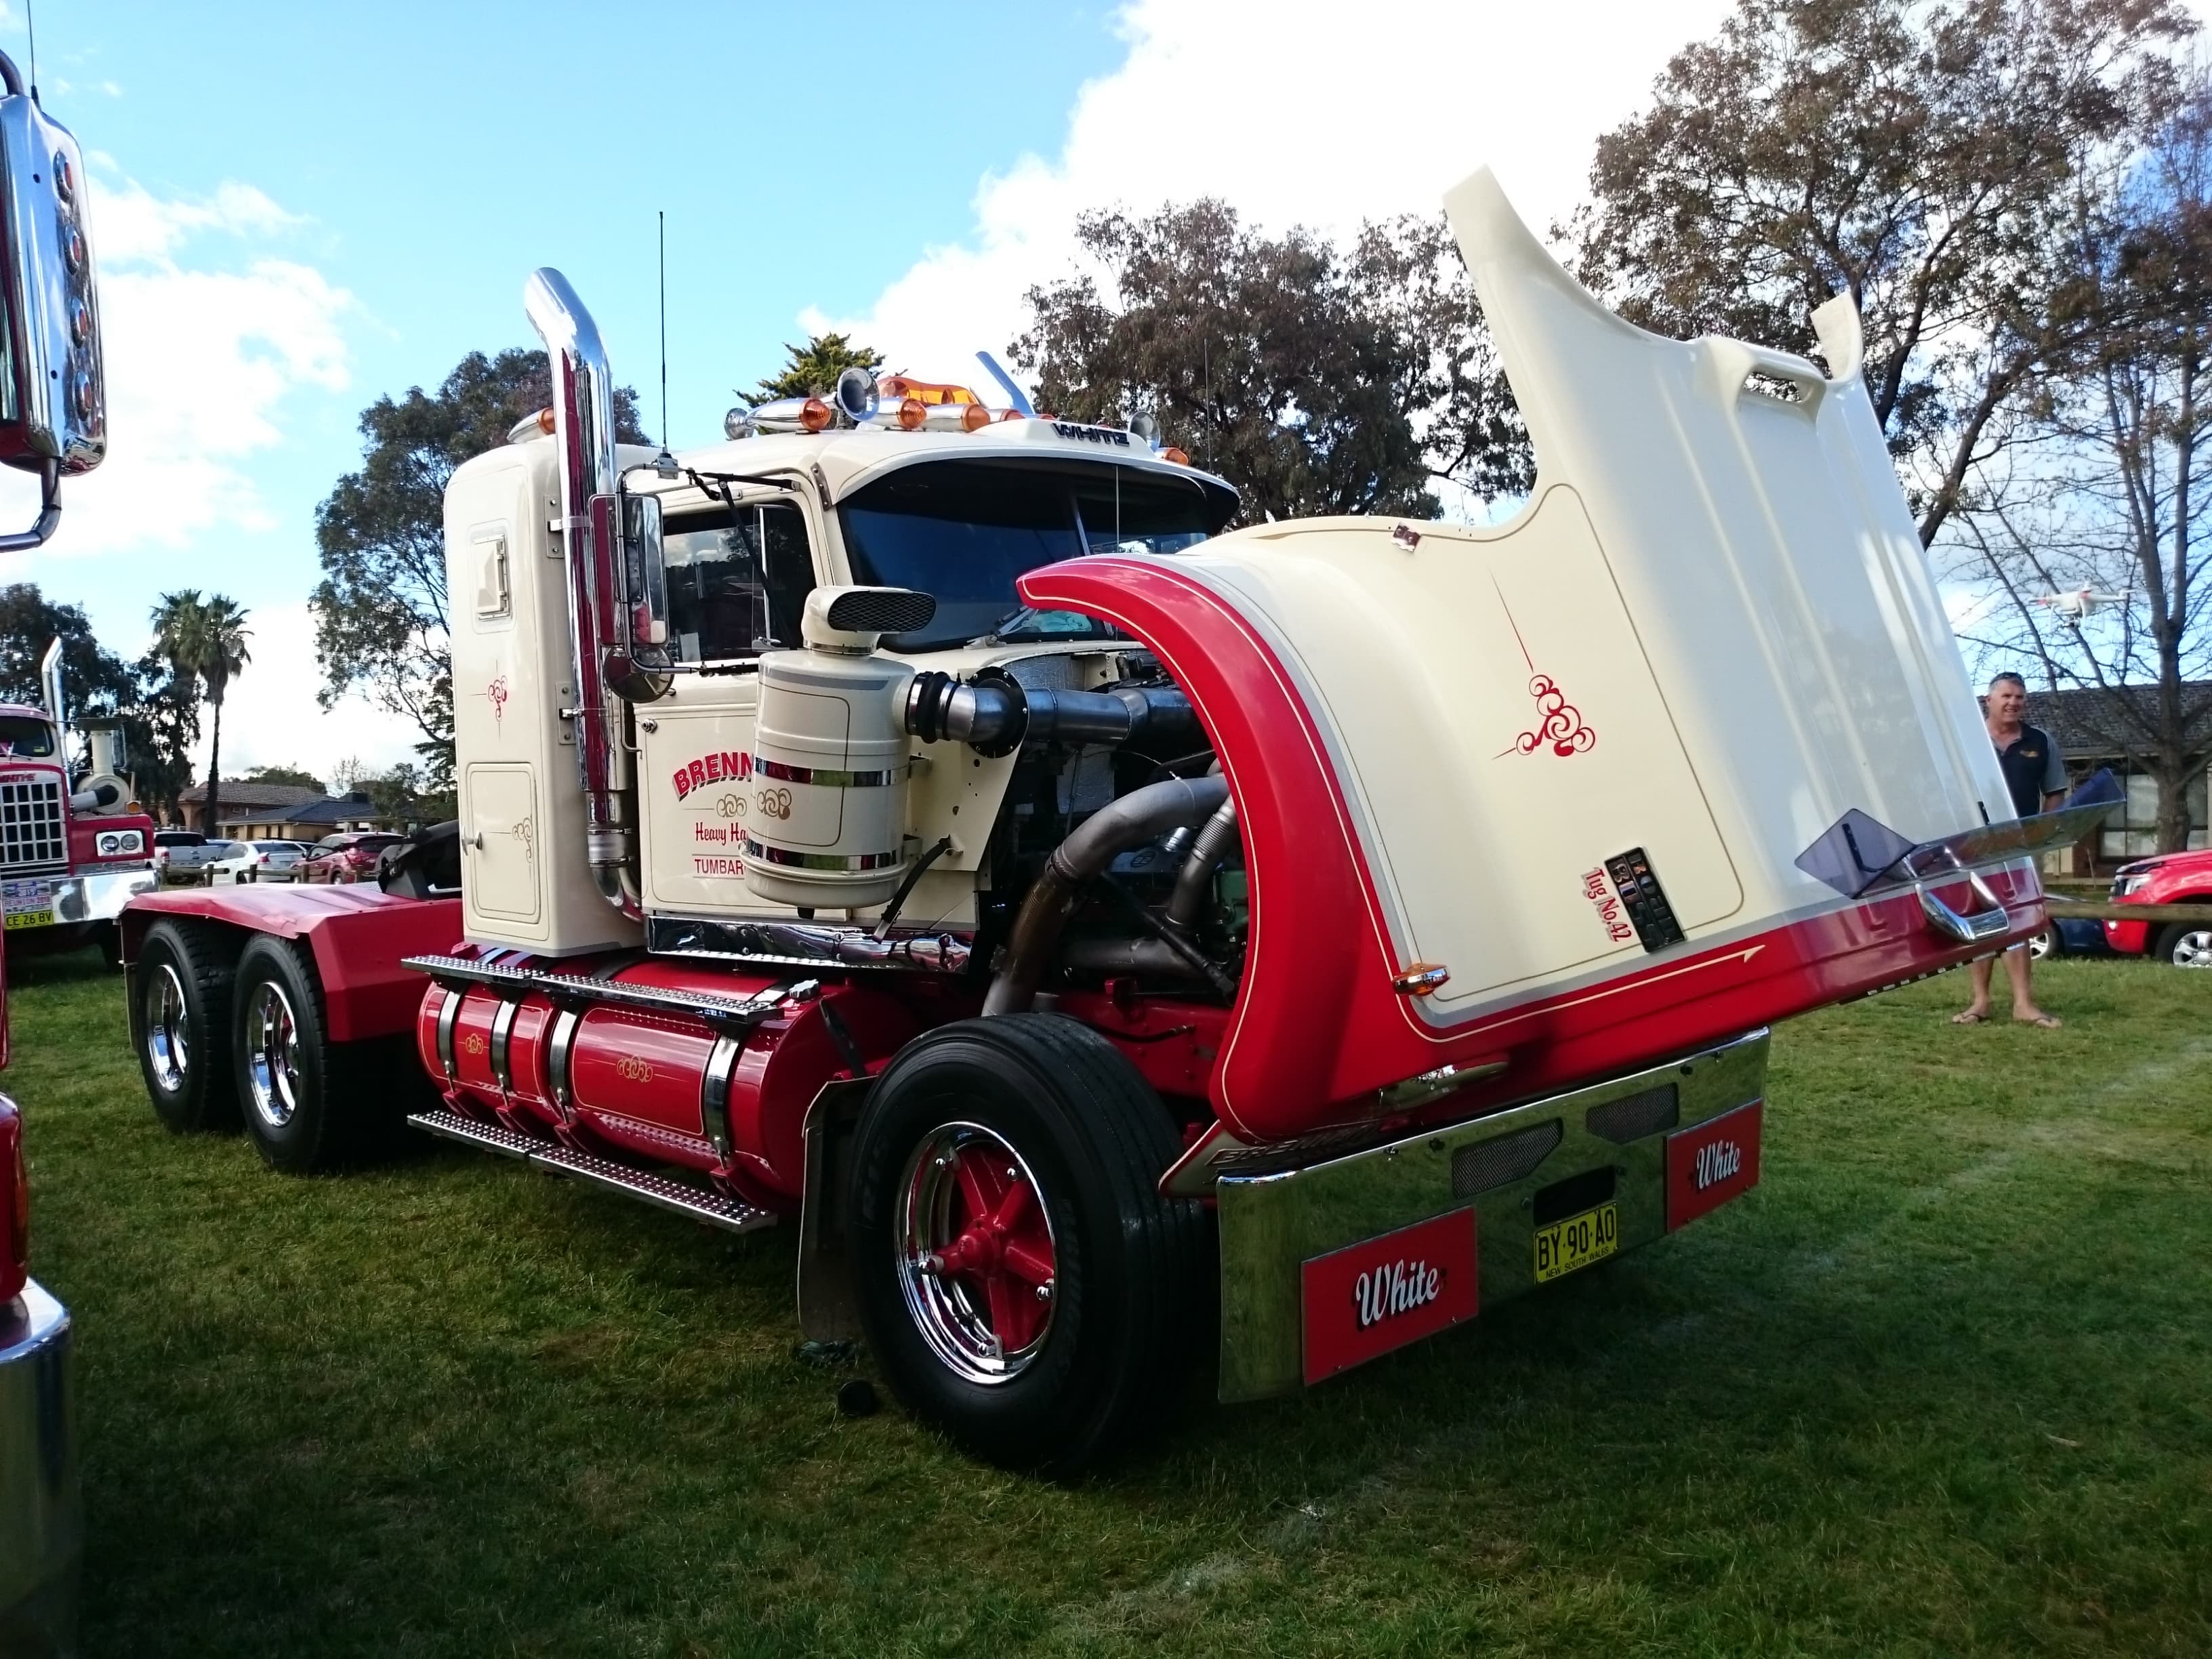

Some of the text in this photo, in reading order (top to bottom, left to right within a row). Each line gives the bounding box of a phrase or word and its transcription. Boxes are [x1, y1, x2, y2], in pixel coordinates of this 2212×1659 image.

[695, 821, 726, 846] Heavy
[694, 858, 746, 875] TUMBAR
[1586, 868, 1607, 900] Tug
[1051, 1101, 1130, 1124] WHITE
[1696, 1139, 1740, 1189] White
[1545, 1246, 1610, 1278] NEW SOUTH WALES
[1355, 1258, 1439, 1326] White
